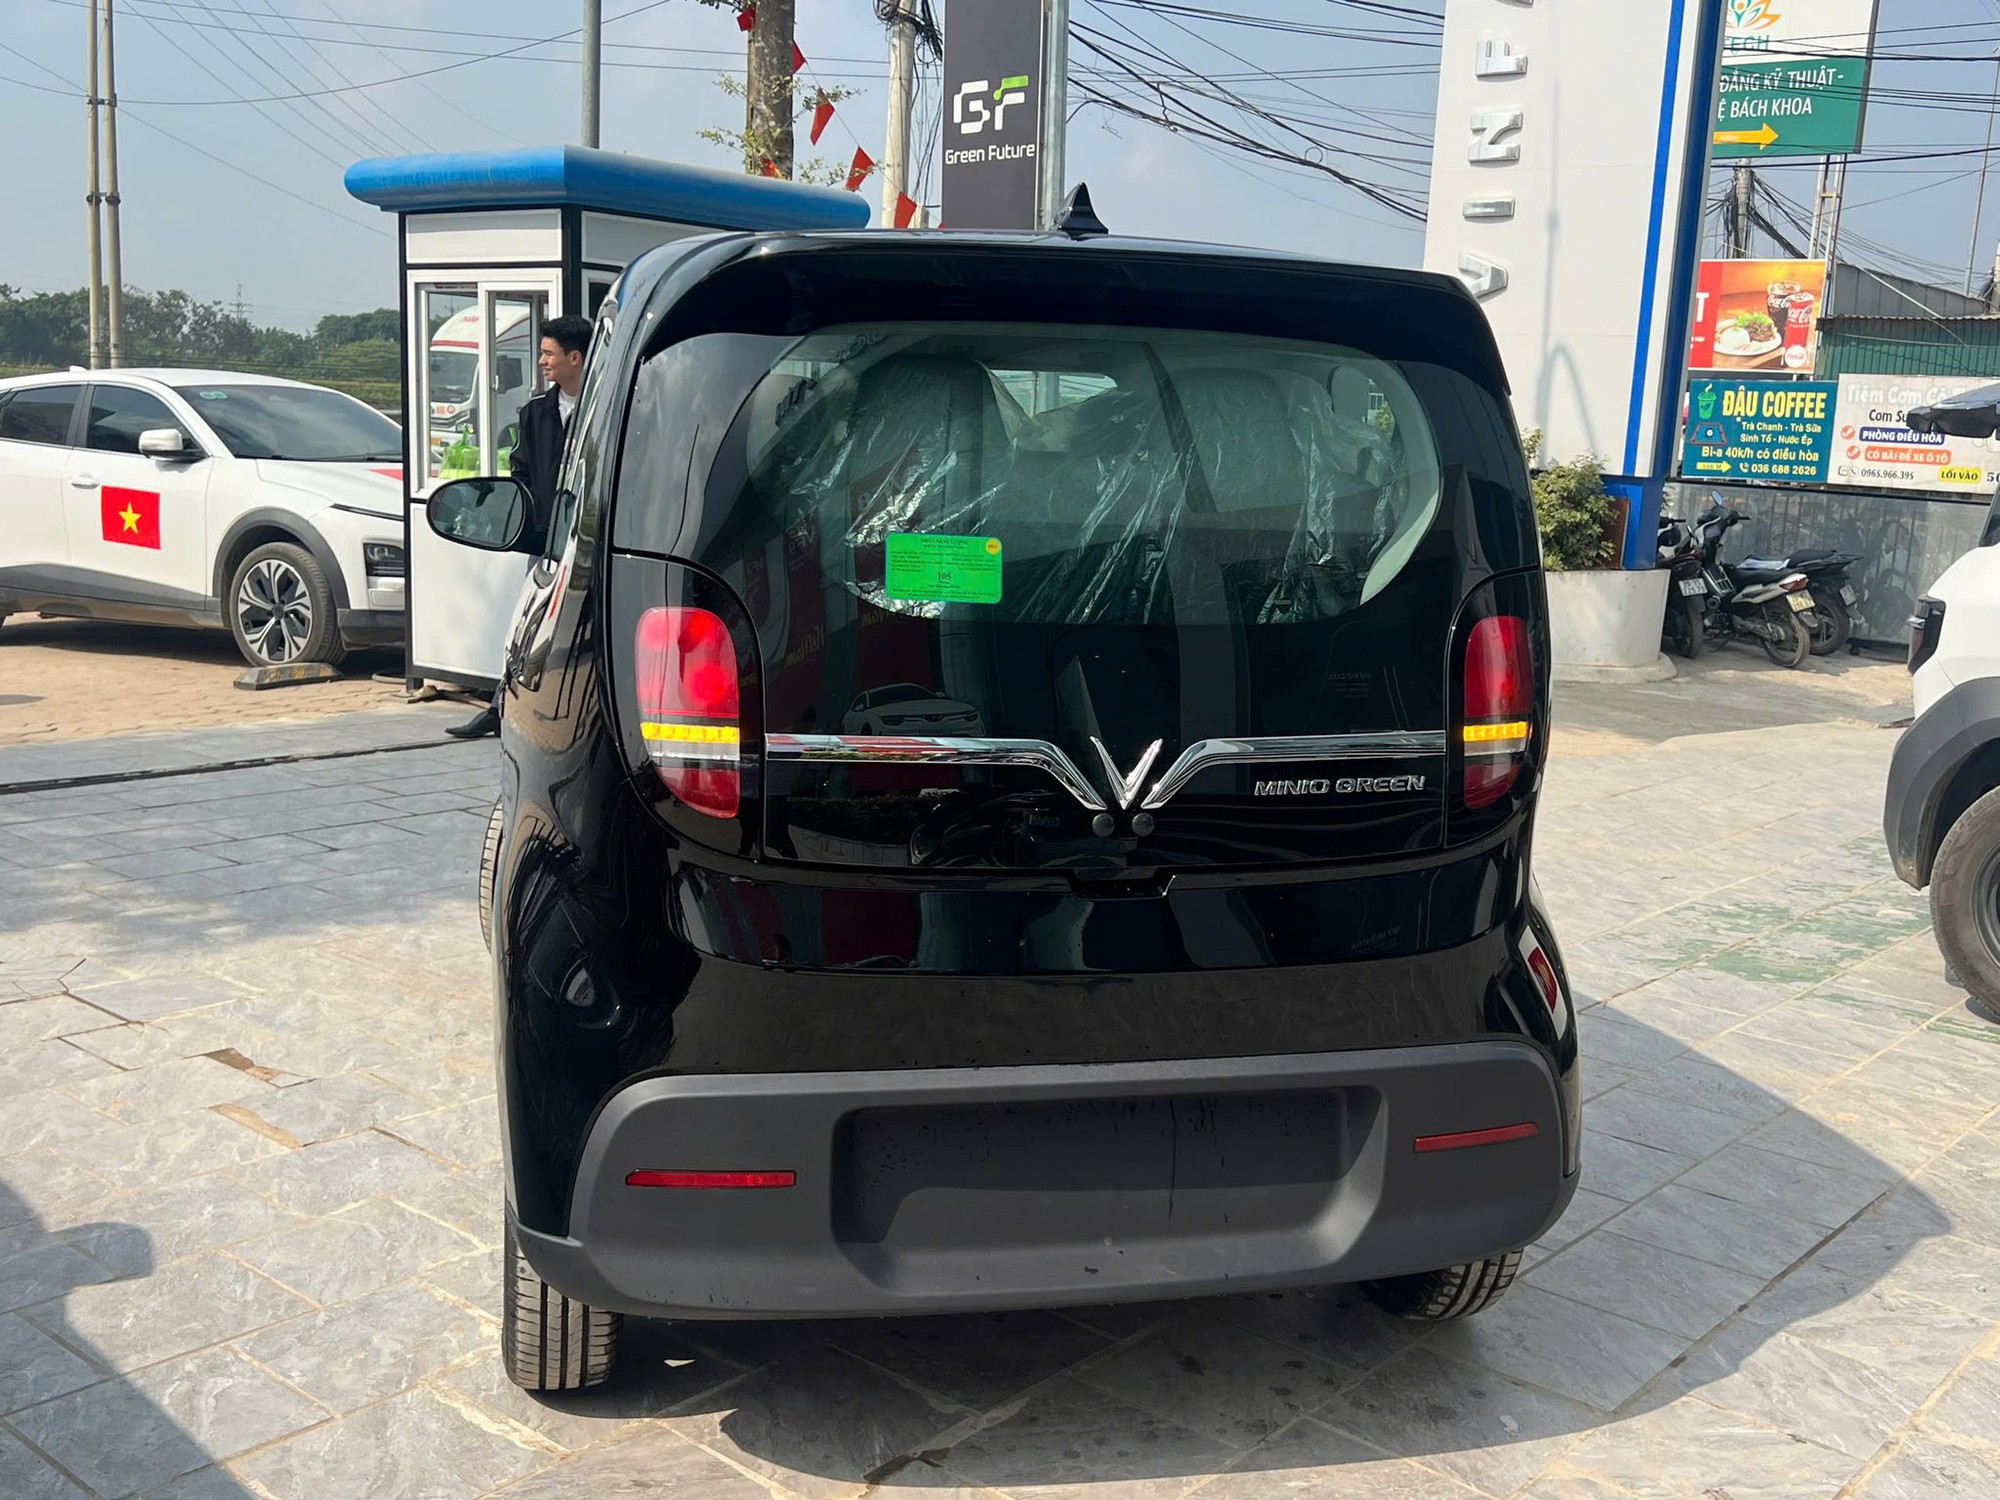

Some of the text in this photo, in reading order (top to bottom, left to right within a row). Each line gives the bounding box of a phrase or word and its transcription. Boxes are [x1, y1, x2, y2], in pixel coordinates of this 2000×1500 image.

[1730, 96, 1768, 119] BÁCH
[1771, 97, 1812, 116] KHOA
[945, 144, 1035, 165] Green Future
[1722, 384, 1827, 422] ĐẬU COFFEE
[1756, 422, 1783, 432] Chanh
[1740, 433, 1759, 443] Sinh
[1862, 430, 1895, 442] PHÒNG
[1921, 431, 1942, 443] HÒA
[1725, 447, 1753, 459] 40k/h
[1756, 448, 1770, 459] có
[1798, 449, 1819, 461] hòa
[1913, 453, 1925, 462] XE
[1751, 463, 1769, 473] 036
[1792, 465, 1817, 475] 2626
[1941, 468, 1957, 479] LỐI
[1958, 470, 1979, 481] VÀO
[937, 572, 952, 580] 105
[1254, 775, 1426, 796] MINIO GREEN
